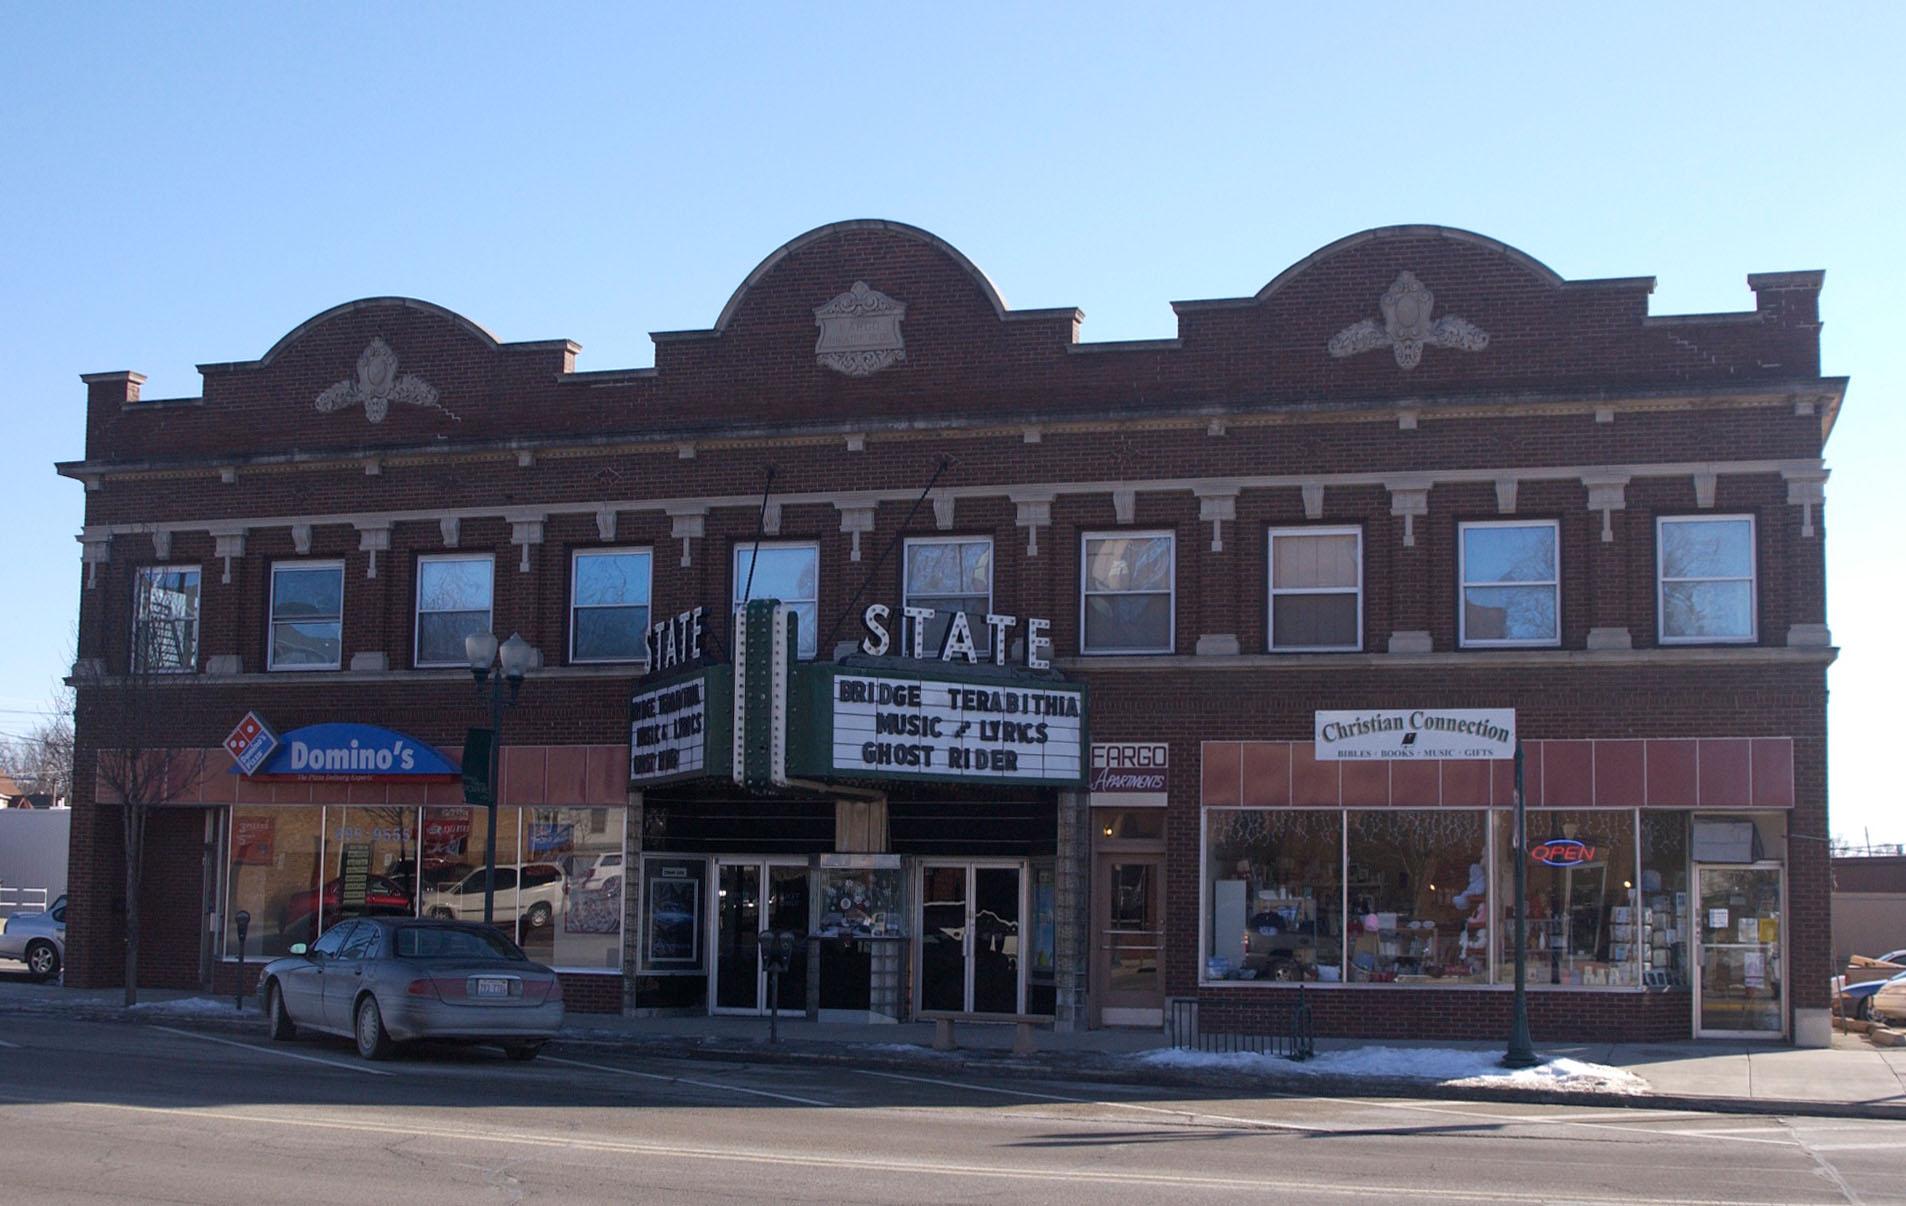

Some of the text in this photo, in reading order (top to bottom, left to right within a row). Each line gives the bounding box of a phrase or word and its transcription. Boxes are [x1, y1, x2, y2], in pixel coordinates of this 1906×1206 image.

[644, 606, 702, 674] STATE
[863, 604, 1050, 669] STATE
[840, 680, 1079, 718] BRIDGE TERABITHIA
[876, 713, 942, 738] MUSIC
[980, 720, 1049, 744] LYRICS
[1322, 711, 1510, 743] Christian Connection
[291, 739, 414, 770] Domino's
[862, 742, 1018, 771] GHOST RIDER
[1091, 746, 1167, 767] FARGO
[1337, 748, 1494, 758] BIBLES BOOKS MUSIC GIFTS
[1531, 845, 1597, 861] OPEN
